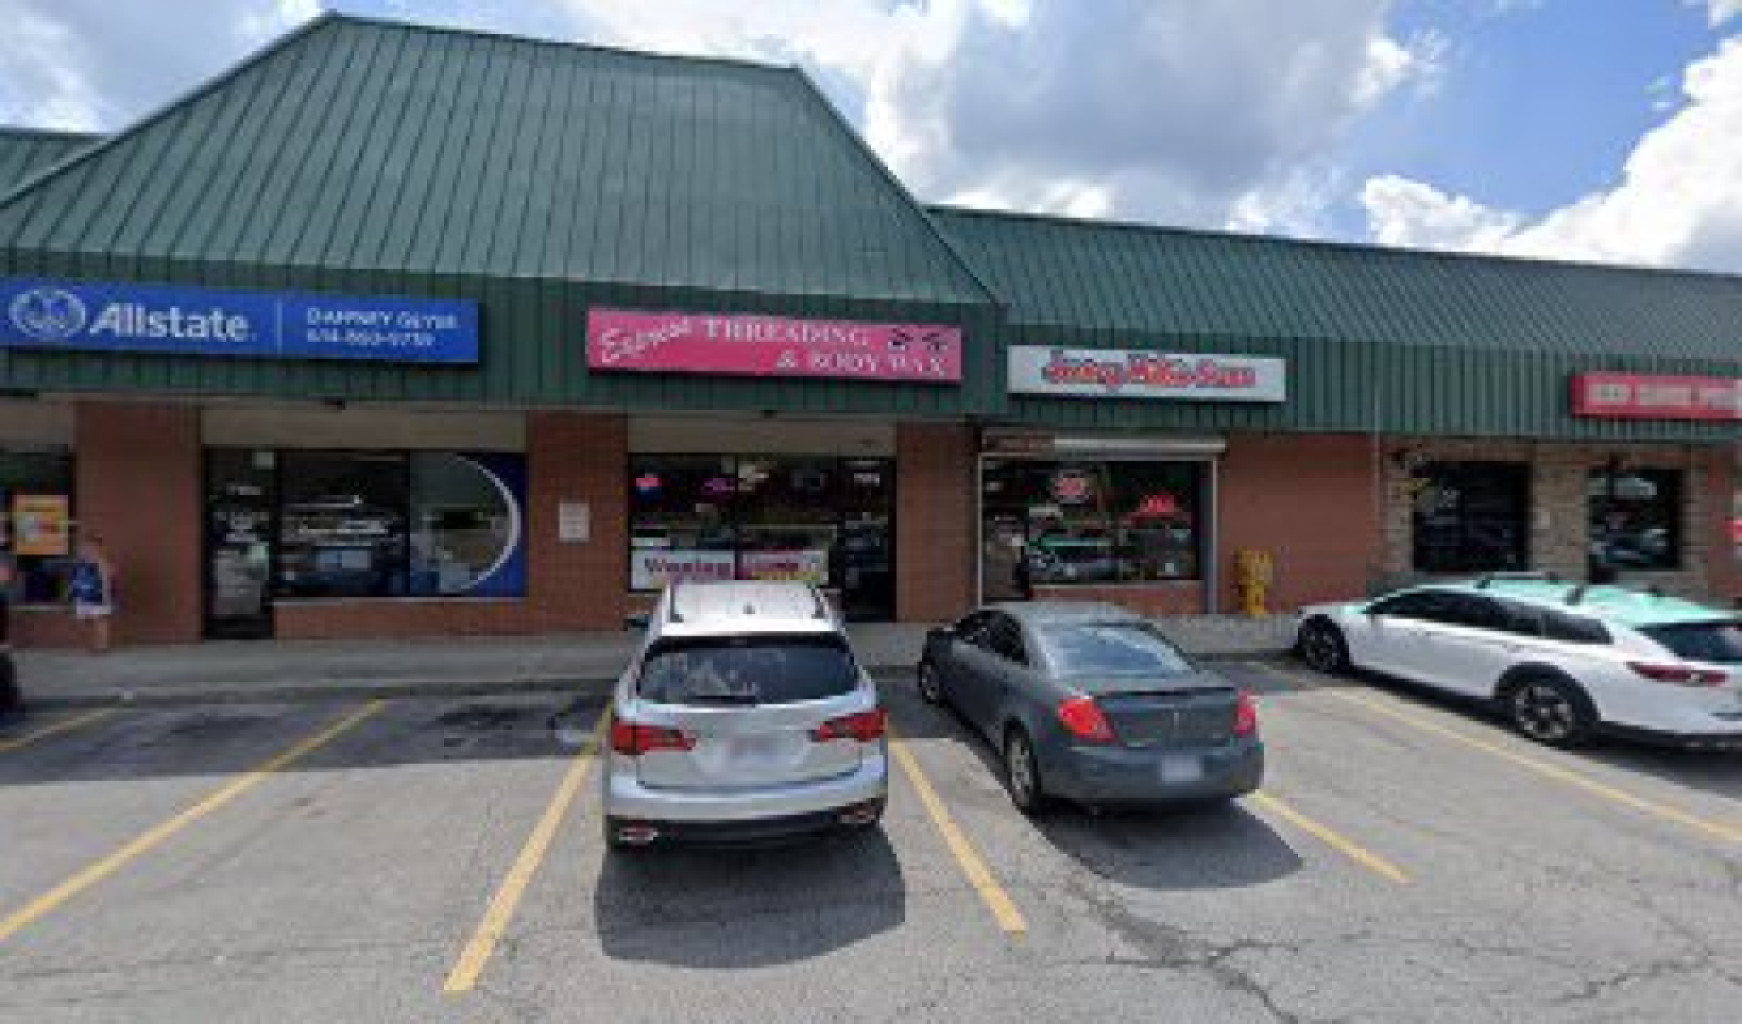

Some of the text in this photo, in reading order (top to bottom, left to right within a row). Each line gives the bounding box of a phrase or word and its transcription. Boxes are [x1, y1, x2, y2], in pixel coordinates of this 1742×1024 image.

[89, 301, 250, 342] Allstate
[703, 317, 871, 347] THREADING
[776, 352, 799, 369] &
[814, 351, 877, 373] BODY
